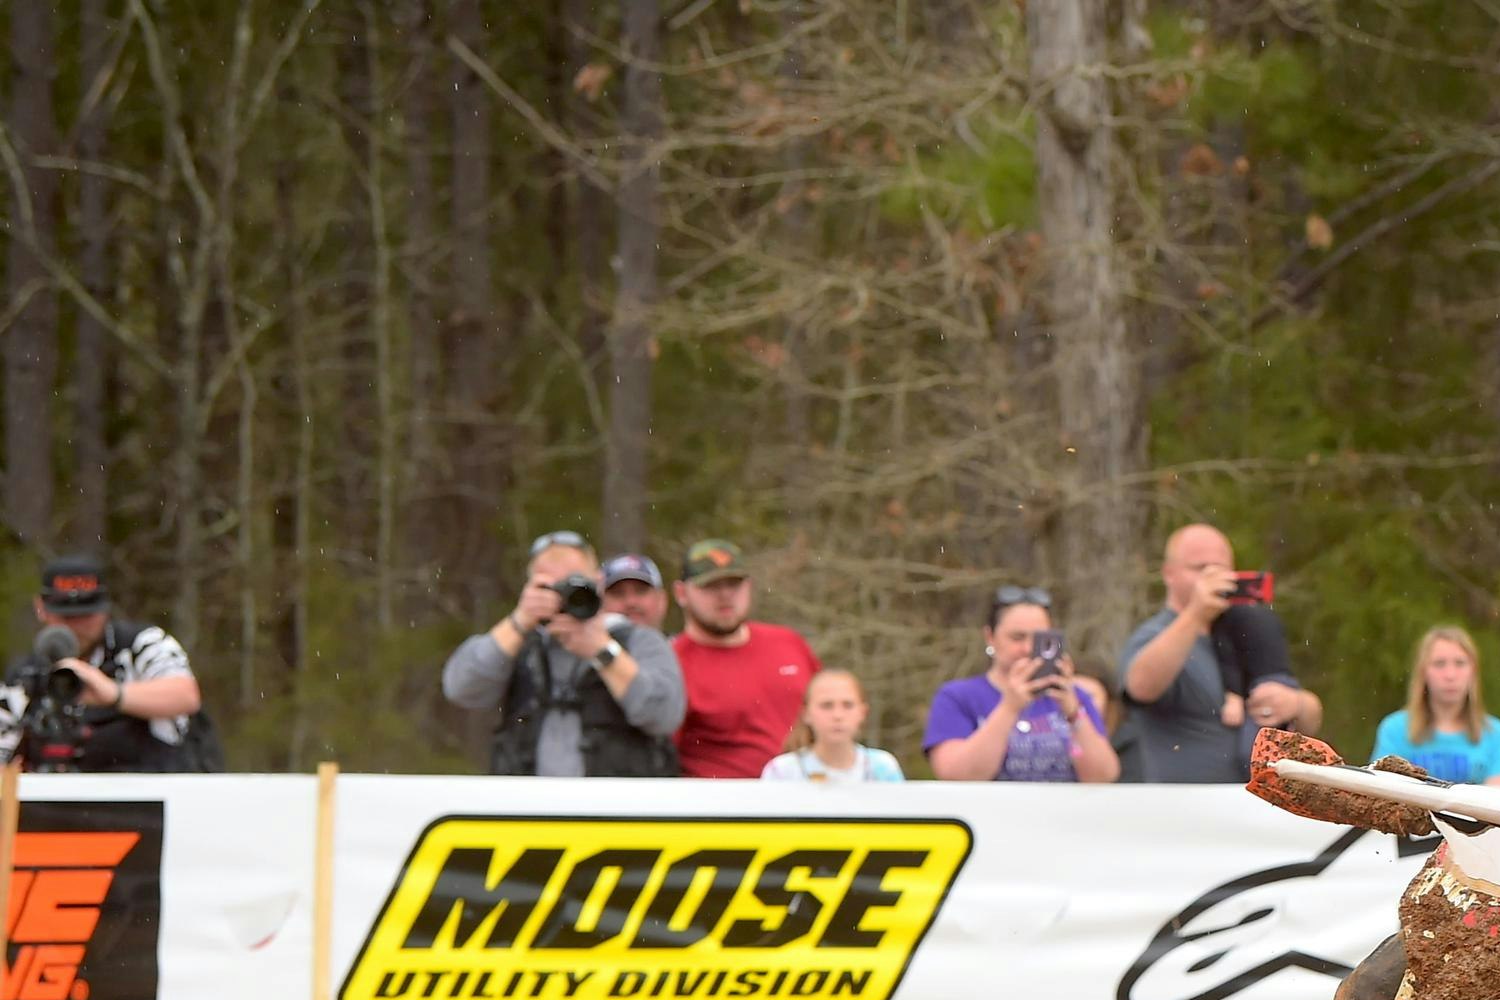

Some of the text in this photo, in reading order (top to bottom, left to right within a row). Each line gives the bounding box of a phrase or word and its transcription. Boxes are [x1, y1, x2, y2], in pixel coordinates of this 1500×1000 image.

[400, 847, 932, 950] MOOSE
[372, 968, 876, 999] UTILITY DIVISION
